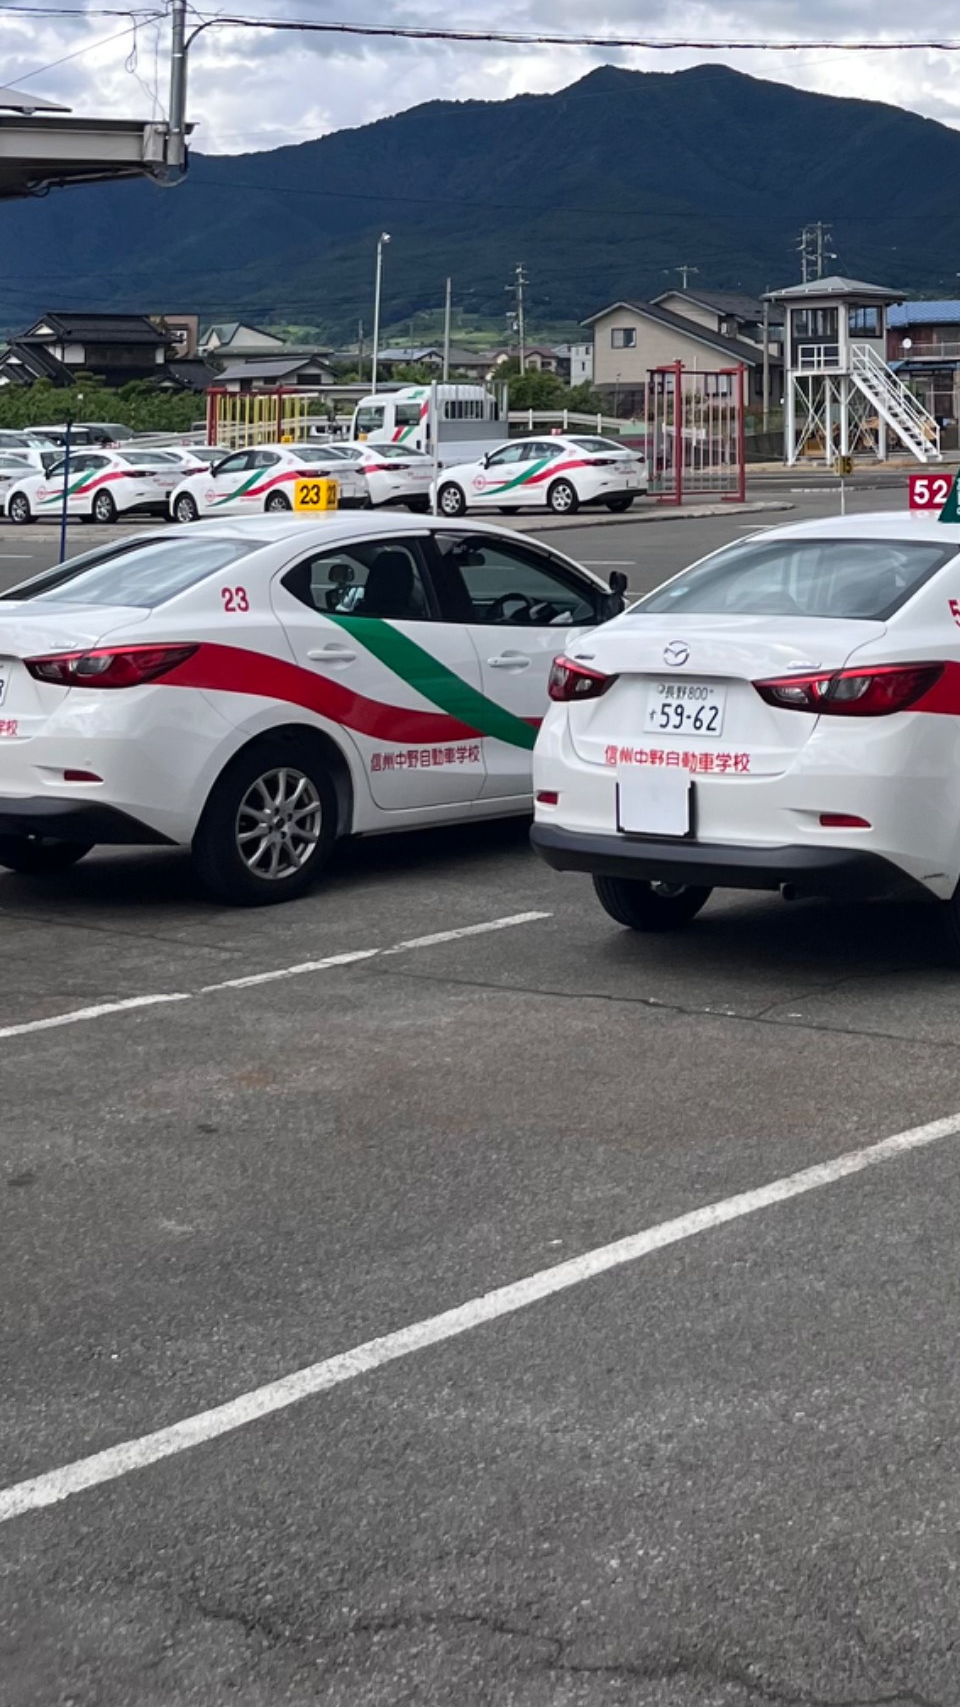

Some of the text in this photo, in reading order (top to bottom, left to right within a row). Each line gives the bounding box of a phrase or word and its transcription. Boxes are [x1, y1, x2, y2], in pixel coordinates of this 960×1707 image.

[300, 484, 320, 505] 23
[913, 479, 948, 505] 52
[221, 586, 249, 613] 23
[659, 703, 719, 731] 59-62
